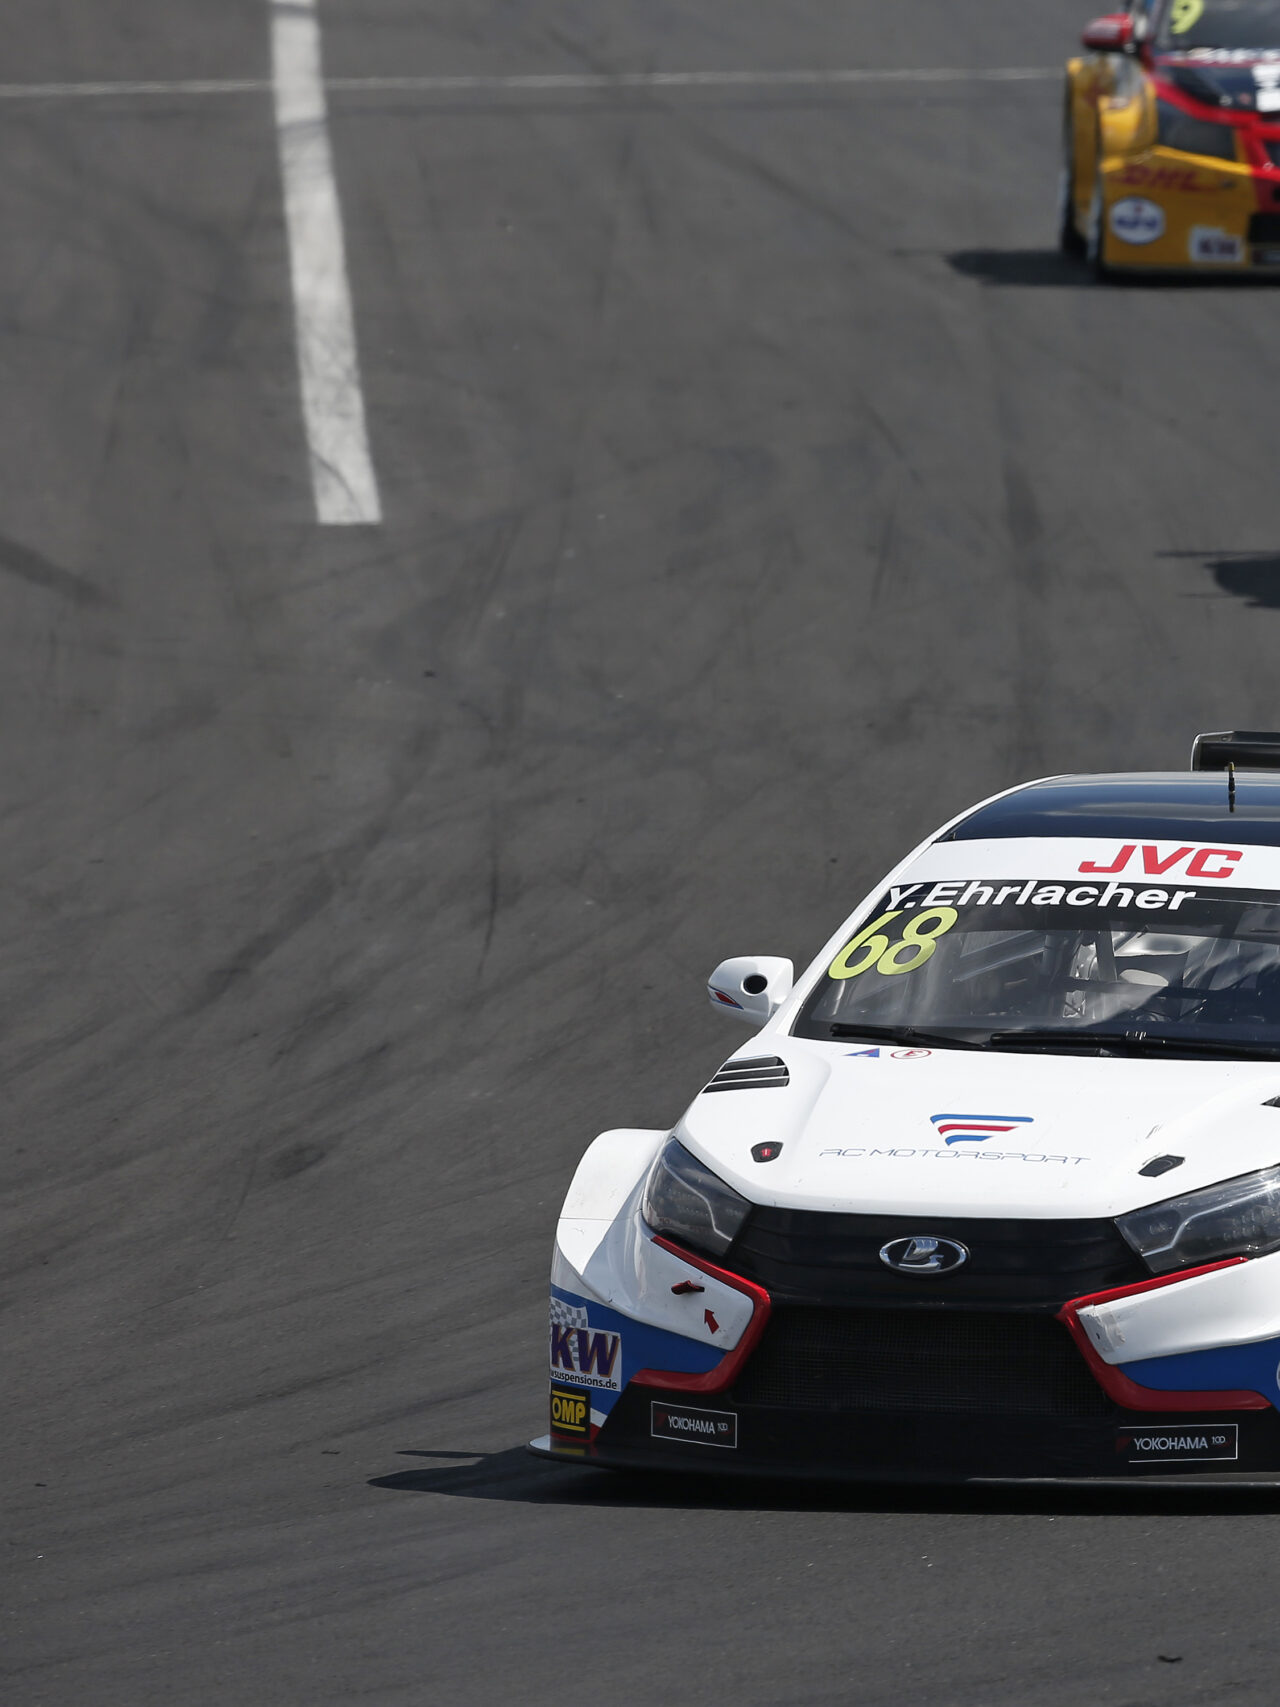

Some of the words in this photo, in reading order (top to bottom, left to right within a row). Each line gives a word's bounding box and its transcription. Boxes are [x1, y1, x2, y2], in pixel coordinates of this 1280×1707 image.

[1077, 844, 1244, 879] JVC
[885, 880, 1197, 912] Y.Ehrlacher
[827, 907, 958, 980] 68
[819, 1148, 866, 1158] RC
[869, 1147, 1091, 1166] MOTORSPORT
[550, 1323, 620, 1378] KW
[552, 1397, 586, 1424] OMP
[668, 1415, 715, 1434] YOKOHAMA
[1134, 1437, 1208, 1451] YOKOHAMA
[1211, 1435, 1226, 1445] 100
